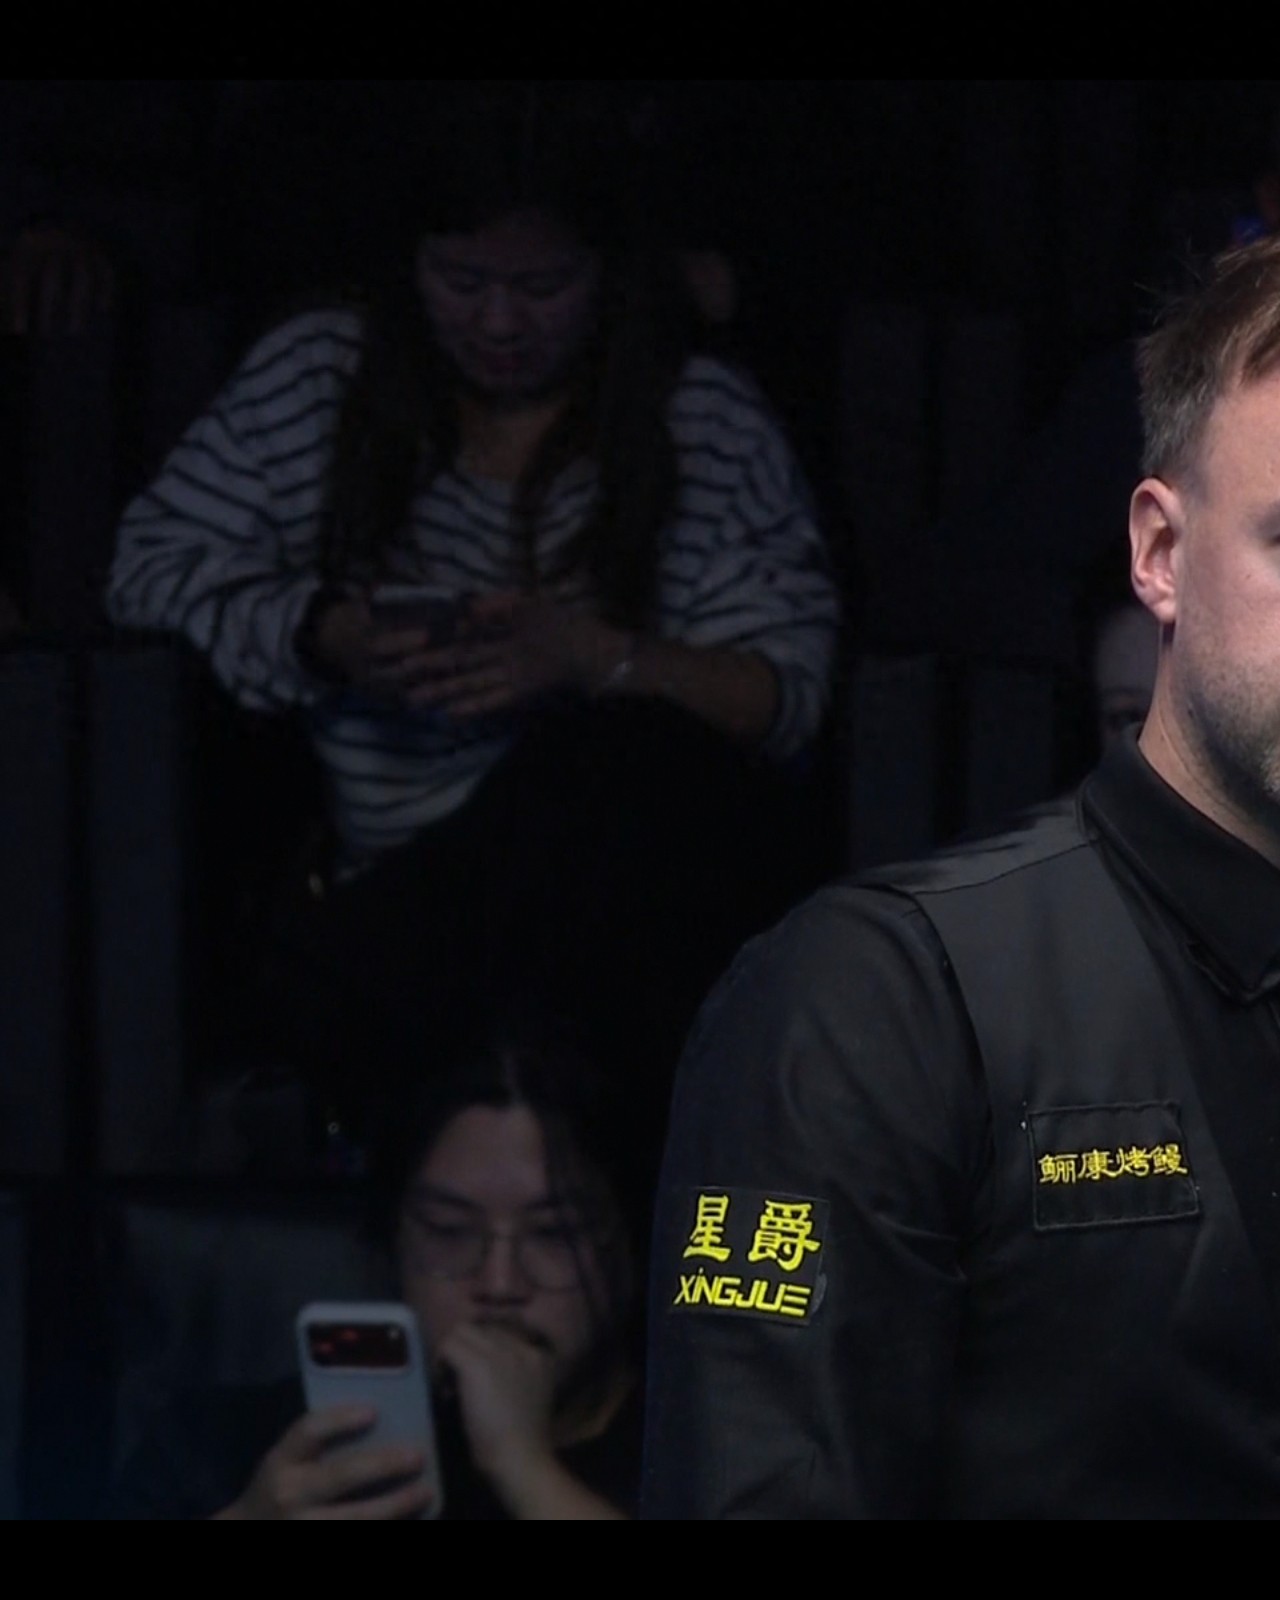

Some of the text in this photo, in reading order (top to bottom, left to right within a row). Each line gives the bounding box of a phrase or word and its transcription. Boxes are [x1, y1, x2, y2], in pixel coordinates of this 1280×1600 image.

[1038, 1142, 1190, 1184] 鲡康烤鳗
[682, 1192, 822, 1272] 星爵
